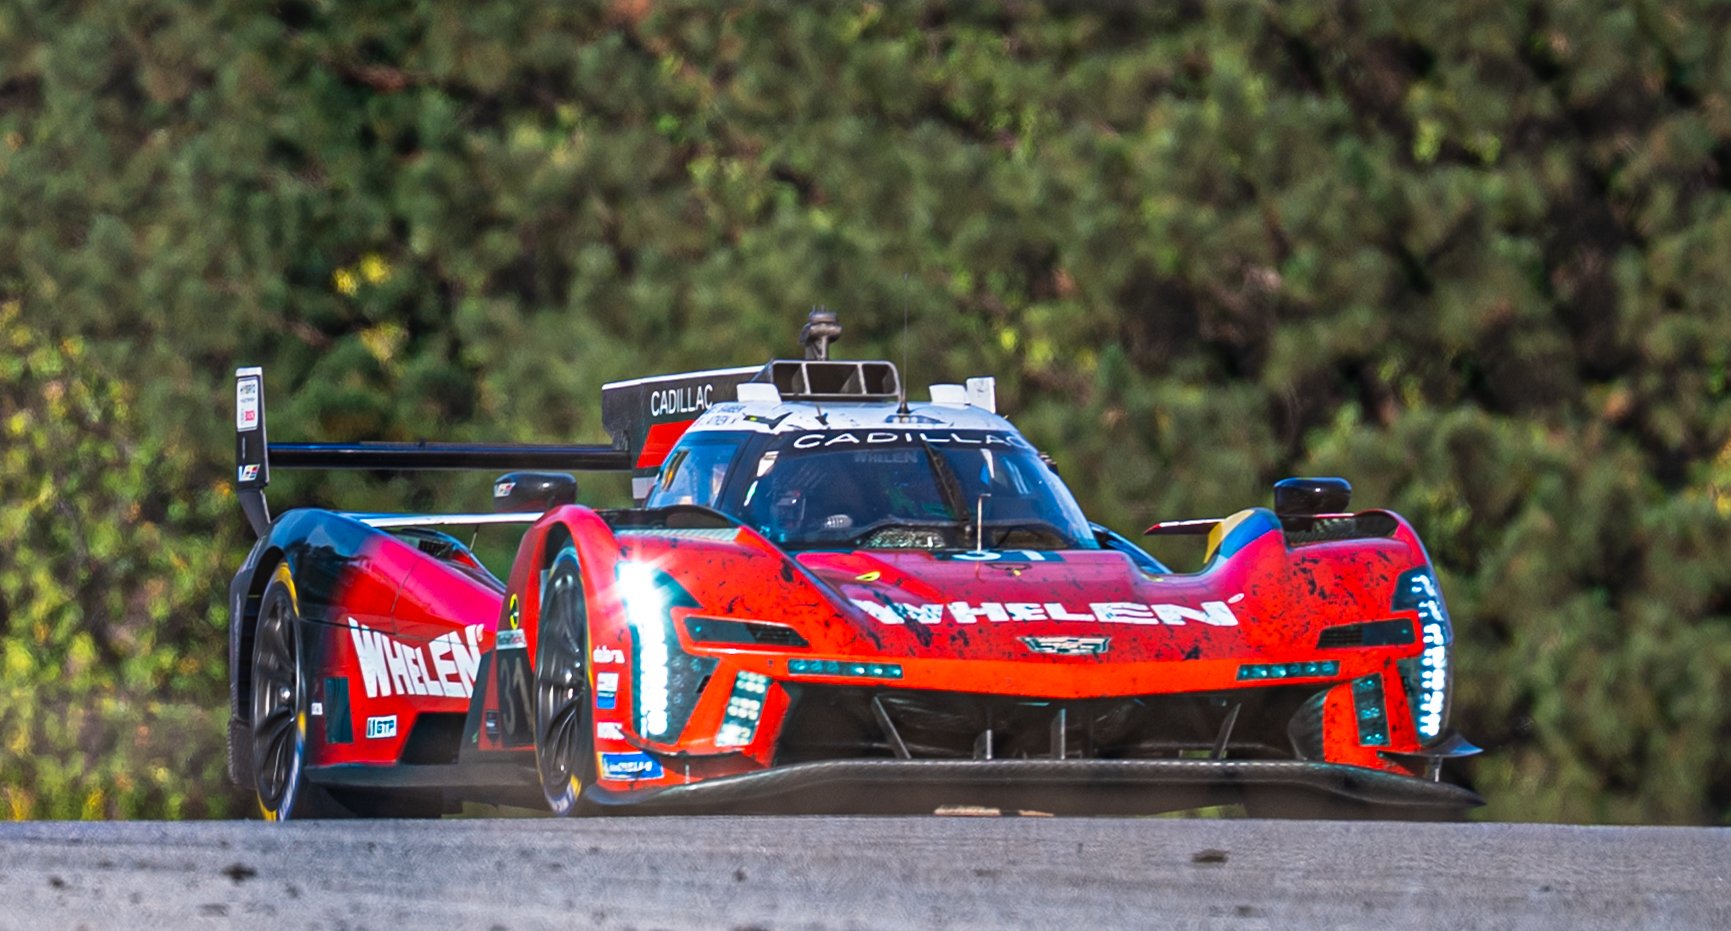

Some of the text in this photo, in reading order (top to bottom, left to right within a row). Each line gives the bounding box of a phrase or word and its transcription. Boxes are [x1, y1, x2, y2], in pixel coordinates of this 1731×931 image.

[650, 384, 713, 417] CADILLAC
[793, 432, 1028, 449] CADILLAC
[854, 451, 919, 463] WHELEN
[850, 600, 1239, 627] WHELEN
[348, 616, 484, 699] WHELEN
[500, 656, 533, 736] 31
